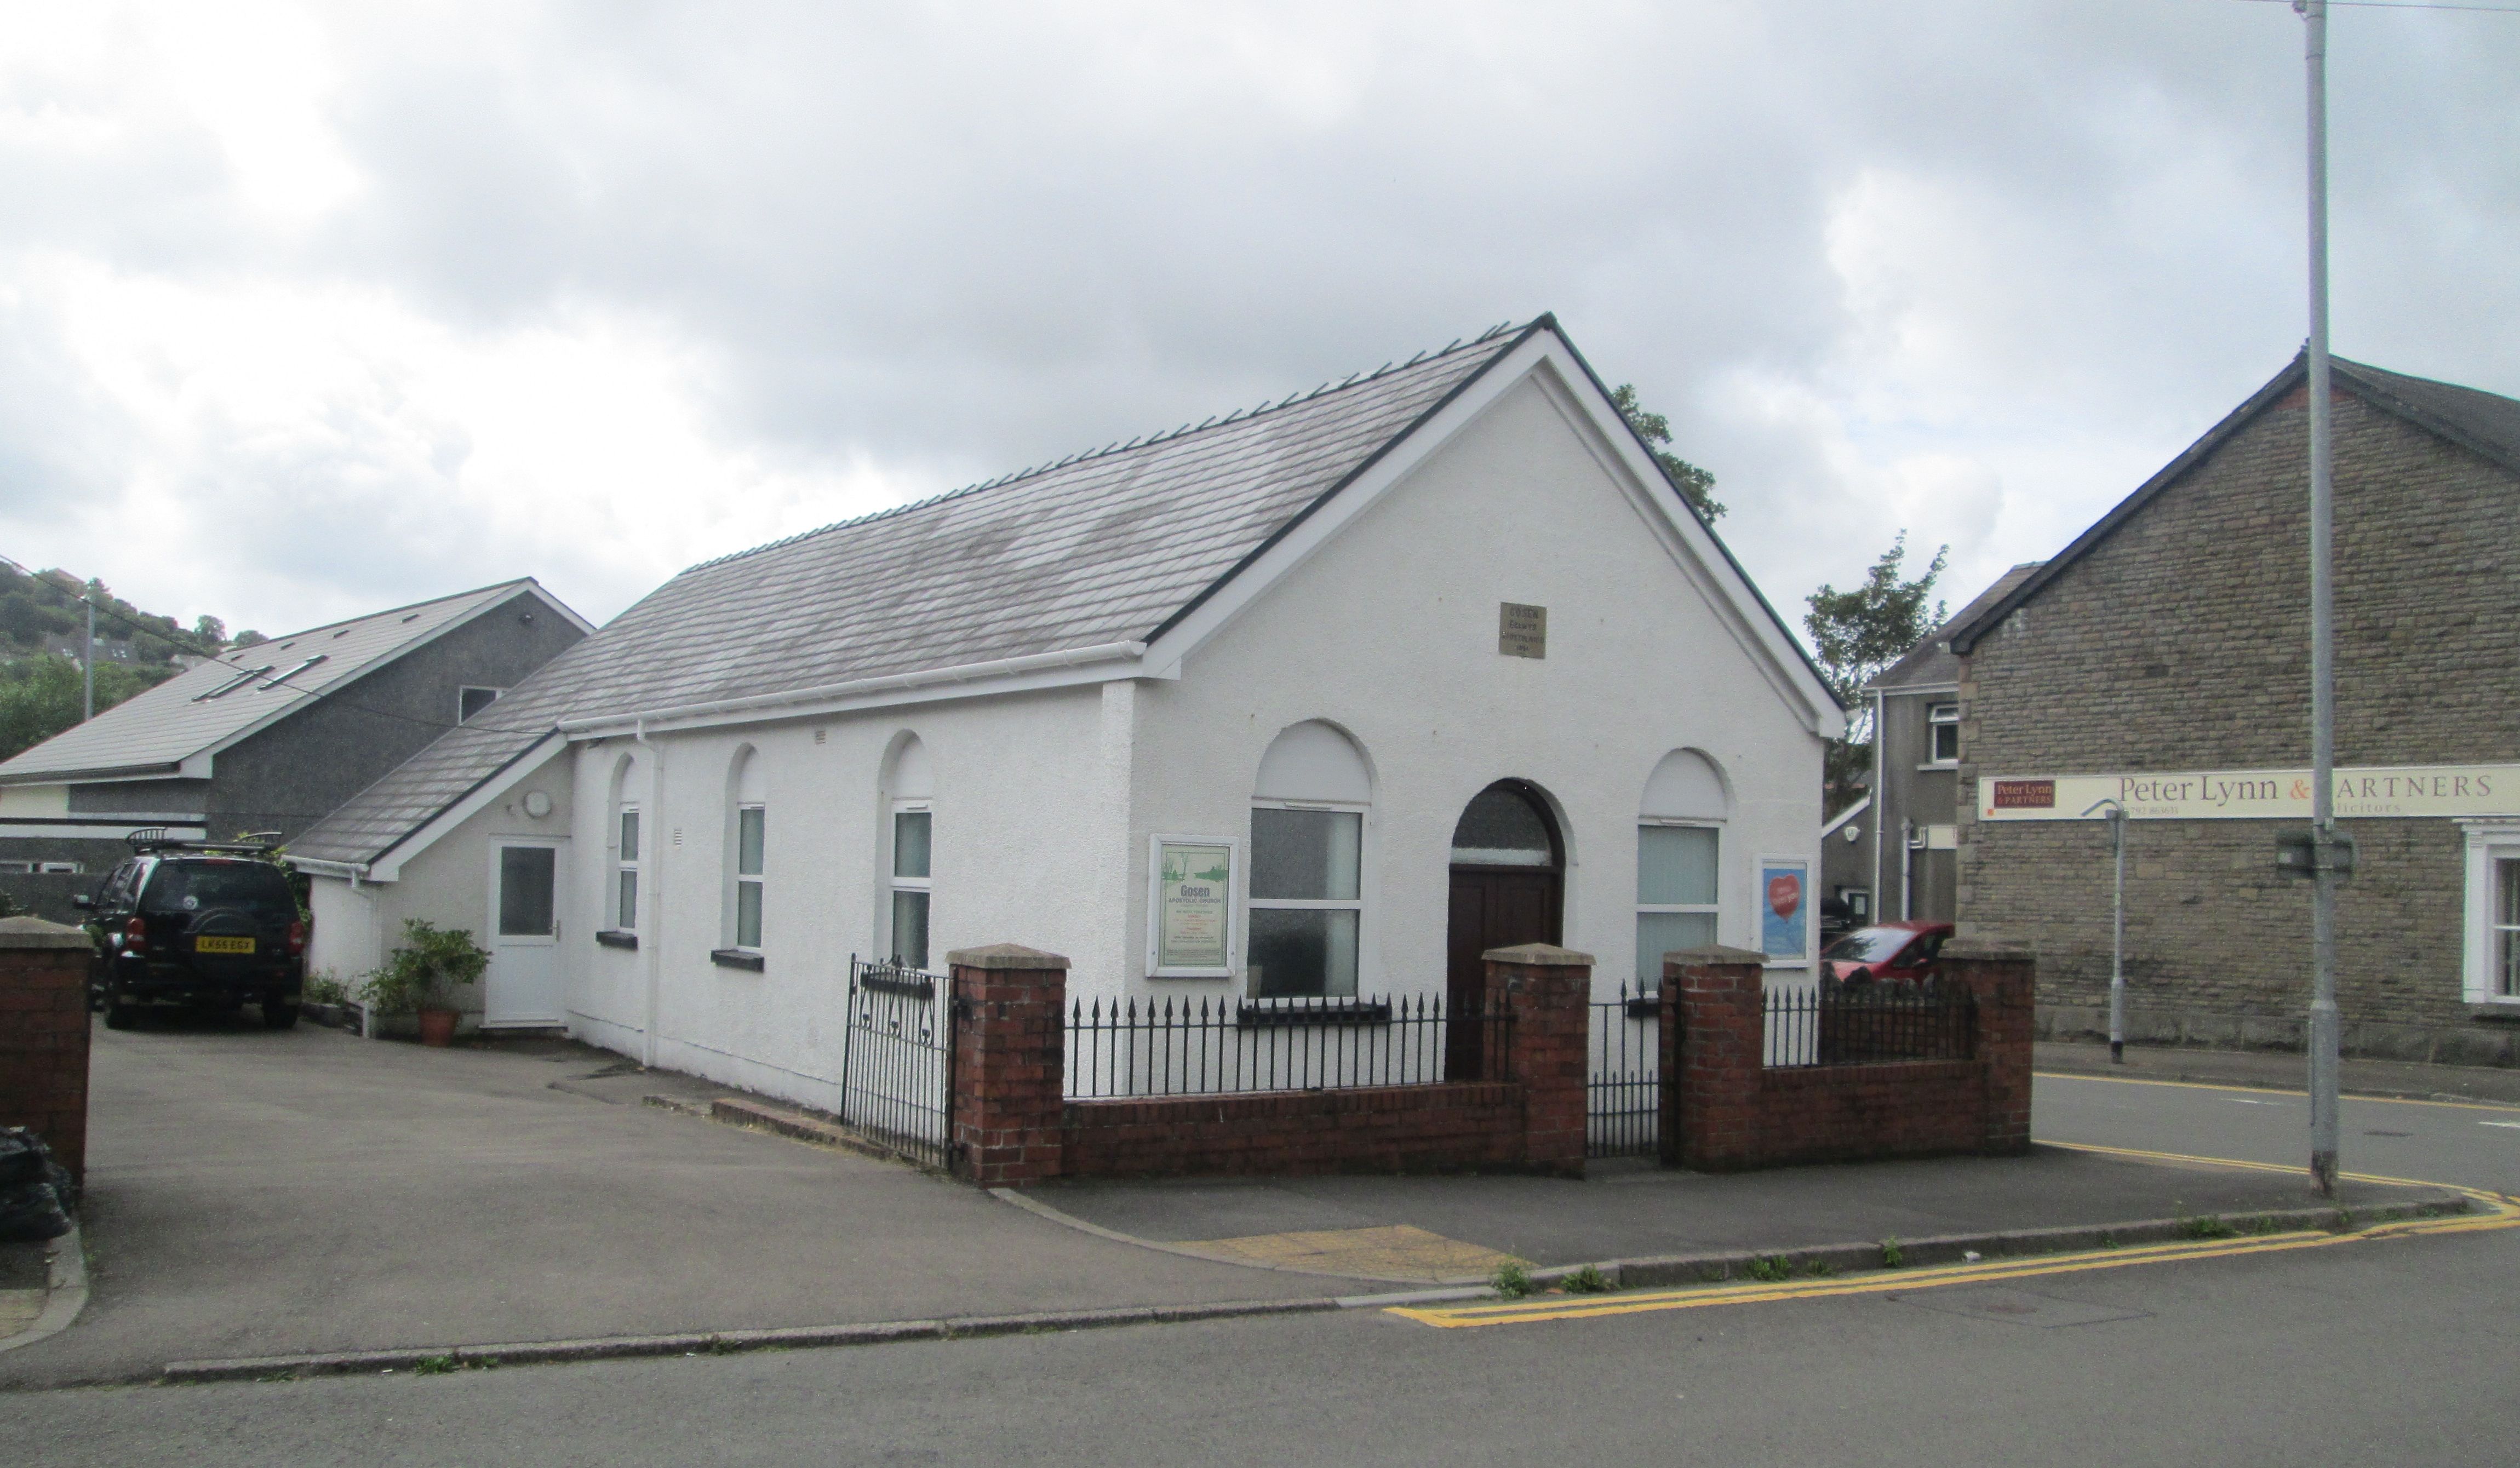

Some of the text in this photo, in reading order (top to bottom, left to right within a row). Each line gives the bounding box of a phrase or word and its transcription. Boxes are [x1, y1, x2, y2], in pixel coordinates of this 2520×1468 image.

[1997, 784, 2052, 796] Peter Lynn
[2120, 775, 2492, 807] Peter Lynn & ARTNERS
[2005, 796, 2052, 804] PARTNERS
[1181, 885, 1210, 897] Gosen
